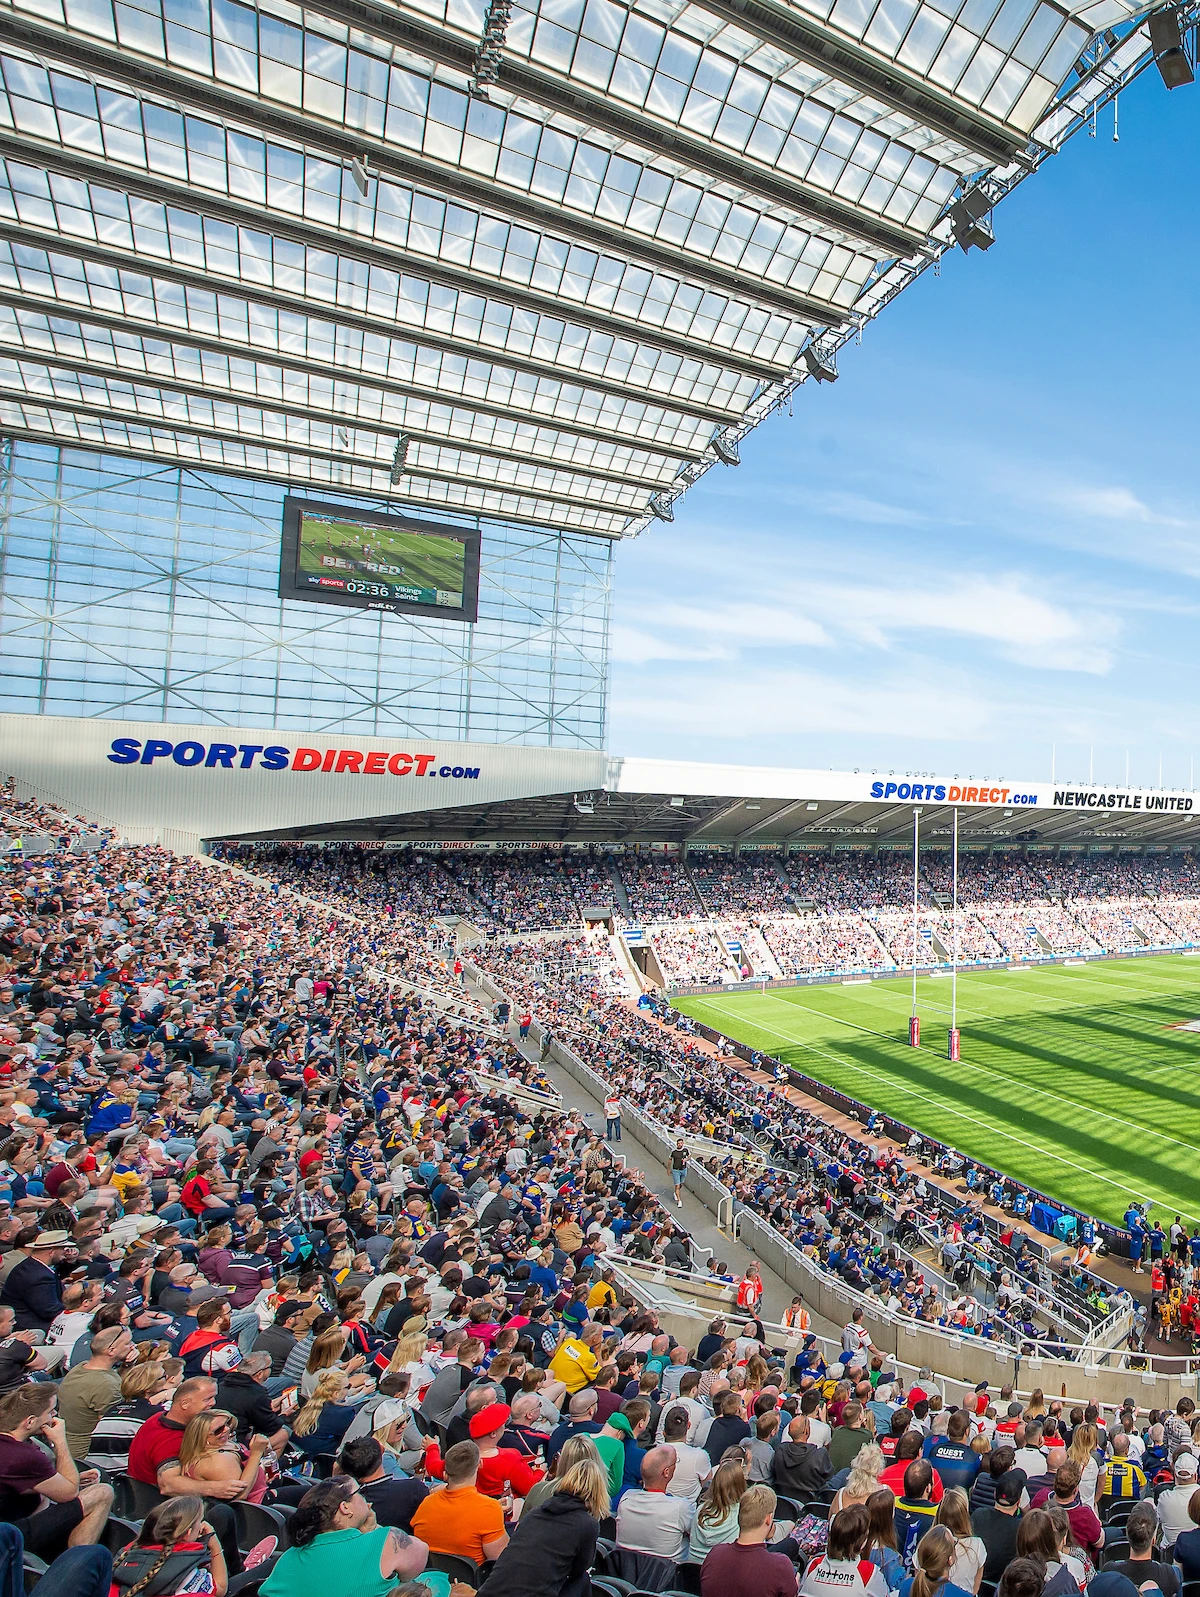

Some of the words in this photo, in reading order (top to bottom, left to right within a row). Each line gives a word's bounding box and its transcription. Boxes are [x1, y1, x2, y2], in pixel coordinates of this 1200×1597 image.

[308, 576, 320, 585] sky
[321, 579, 344, 587] sports
[346, 582, 389, 598] 02:36
[395, 586, 422, 596] Vikings
[394, 593, 419, 602] Saints
[367, 602, 397, 611] adi.tv
[1053, 791, 1142, 809] NEWCASTLE
[1145, 796, 1193, 811] UNITED
[937, 1447, 965, 1457] QUEST
[816, 1567, 855, 1582] Hattons
